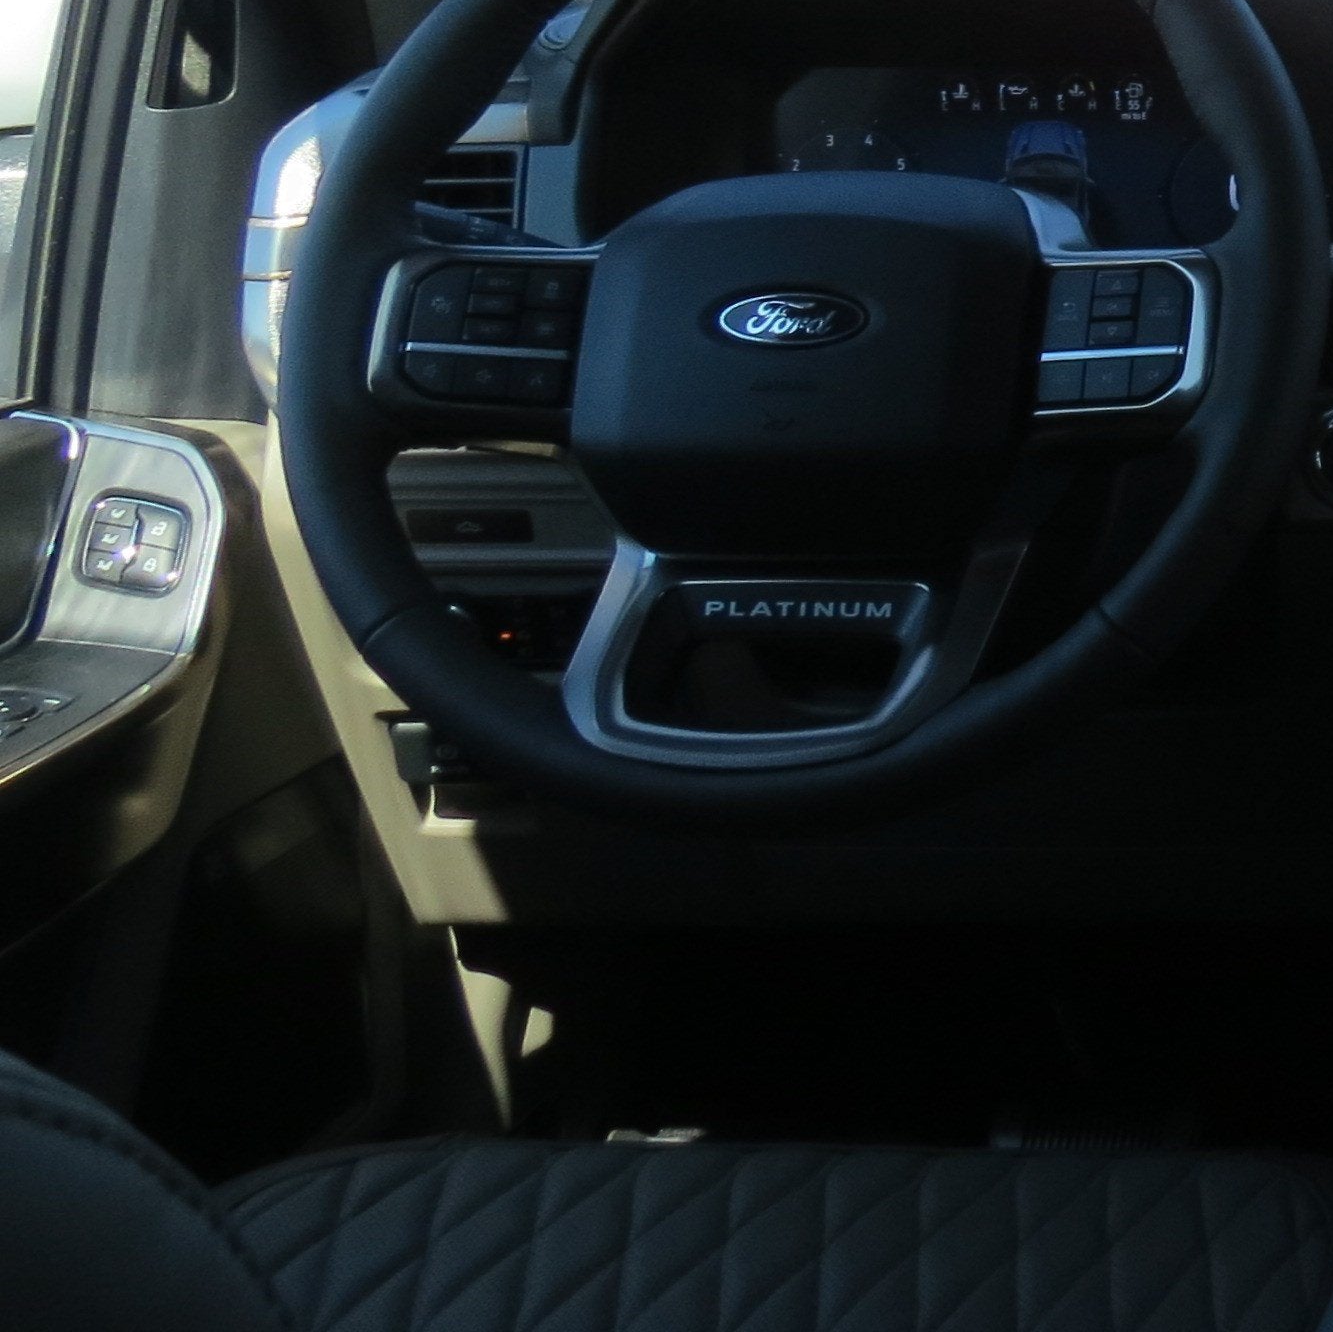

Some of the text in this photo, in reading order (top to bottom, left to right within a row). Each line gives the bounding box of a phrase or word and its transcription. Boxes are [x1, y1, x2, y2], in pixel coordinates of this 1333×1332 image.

[1128, 99, 1140, 110] 55
[826, 135, 834, 146] 3
[864, 134, 873, 145] 4
[792, 159, 800, 171] 2
[897, 158, 906, 170] 5
[746, 300, 837, 335] Ford
[704, 600, 892, 618] PLATINUM
